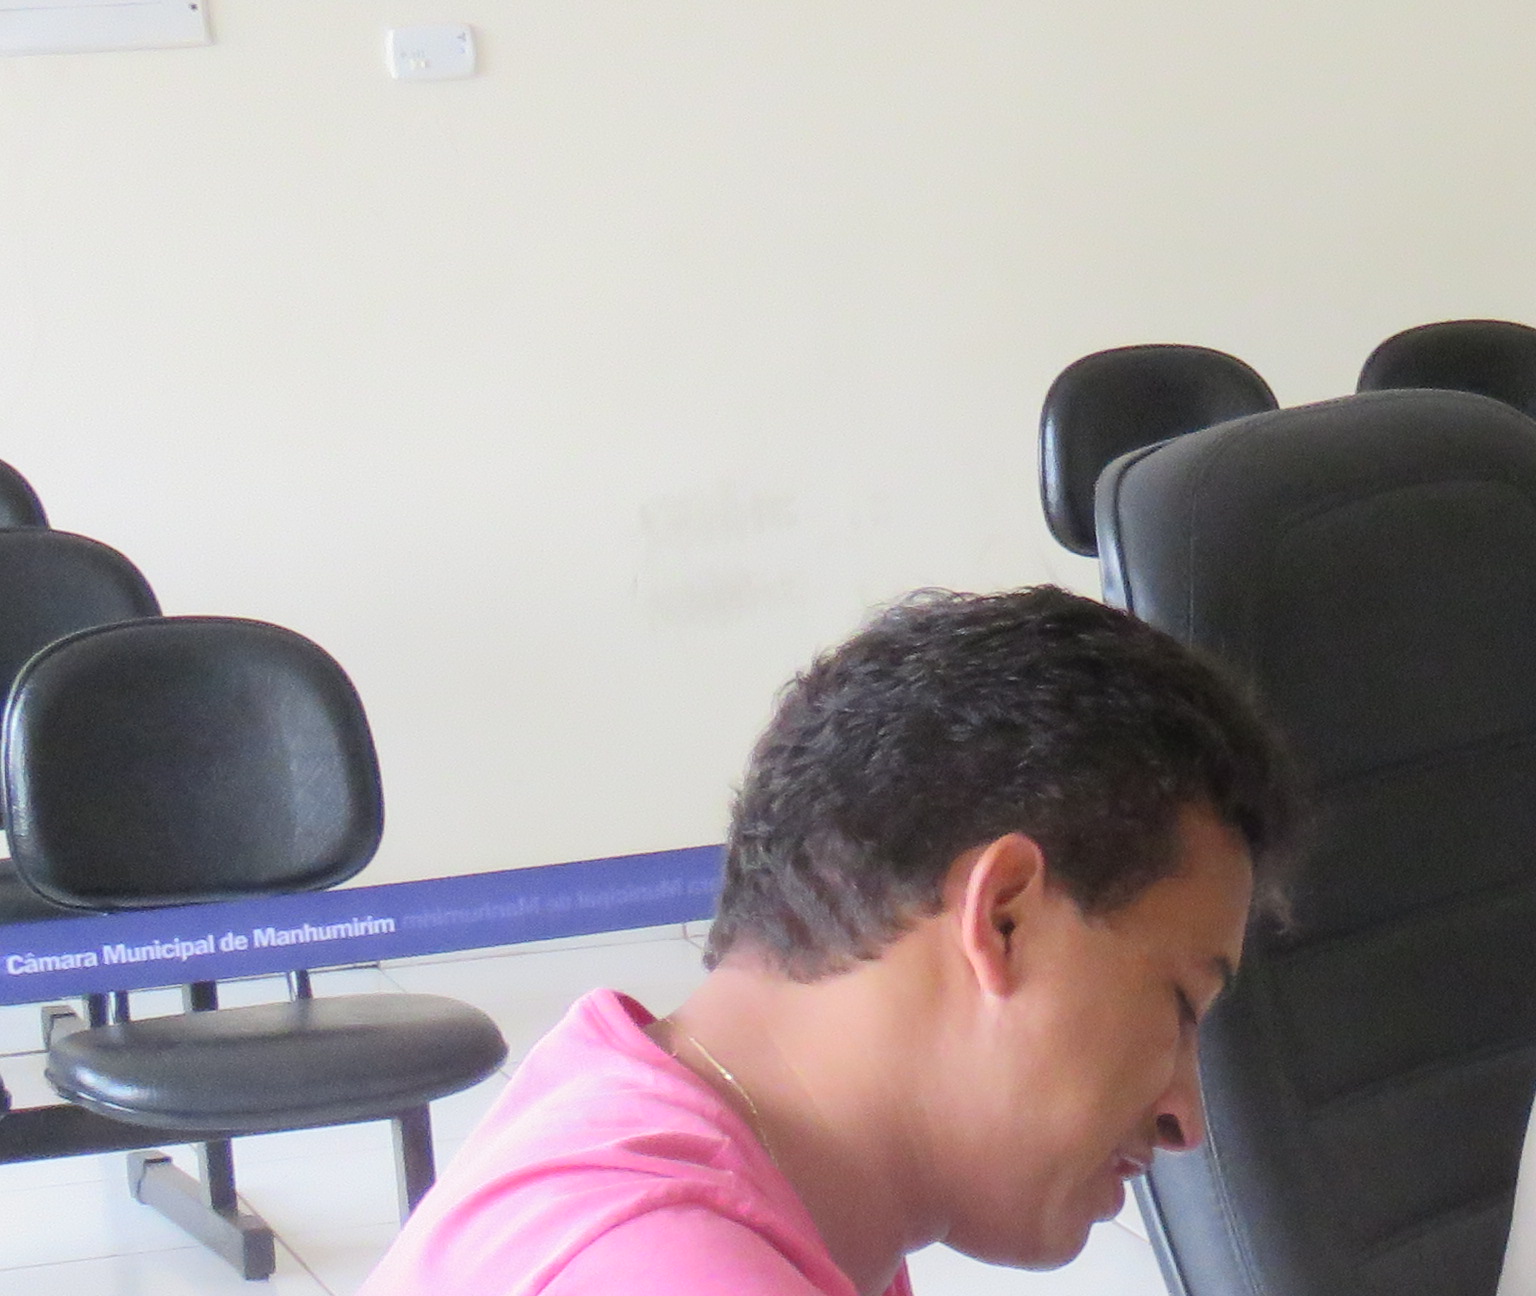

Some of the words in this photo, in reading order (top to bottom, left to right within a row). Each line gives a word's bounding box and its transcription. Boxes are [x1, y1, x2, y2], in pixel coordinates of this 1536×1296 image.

[7, 952, 98, 975] Câmara
[103, 935, 215, 963] Municipal
[219, 931, 248, 952] de
[253, 915, 395, 948] Manhumirim
